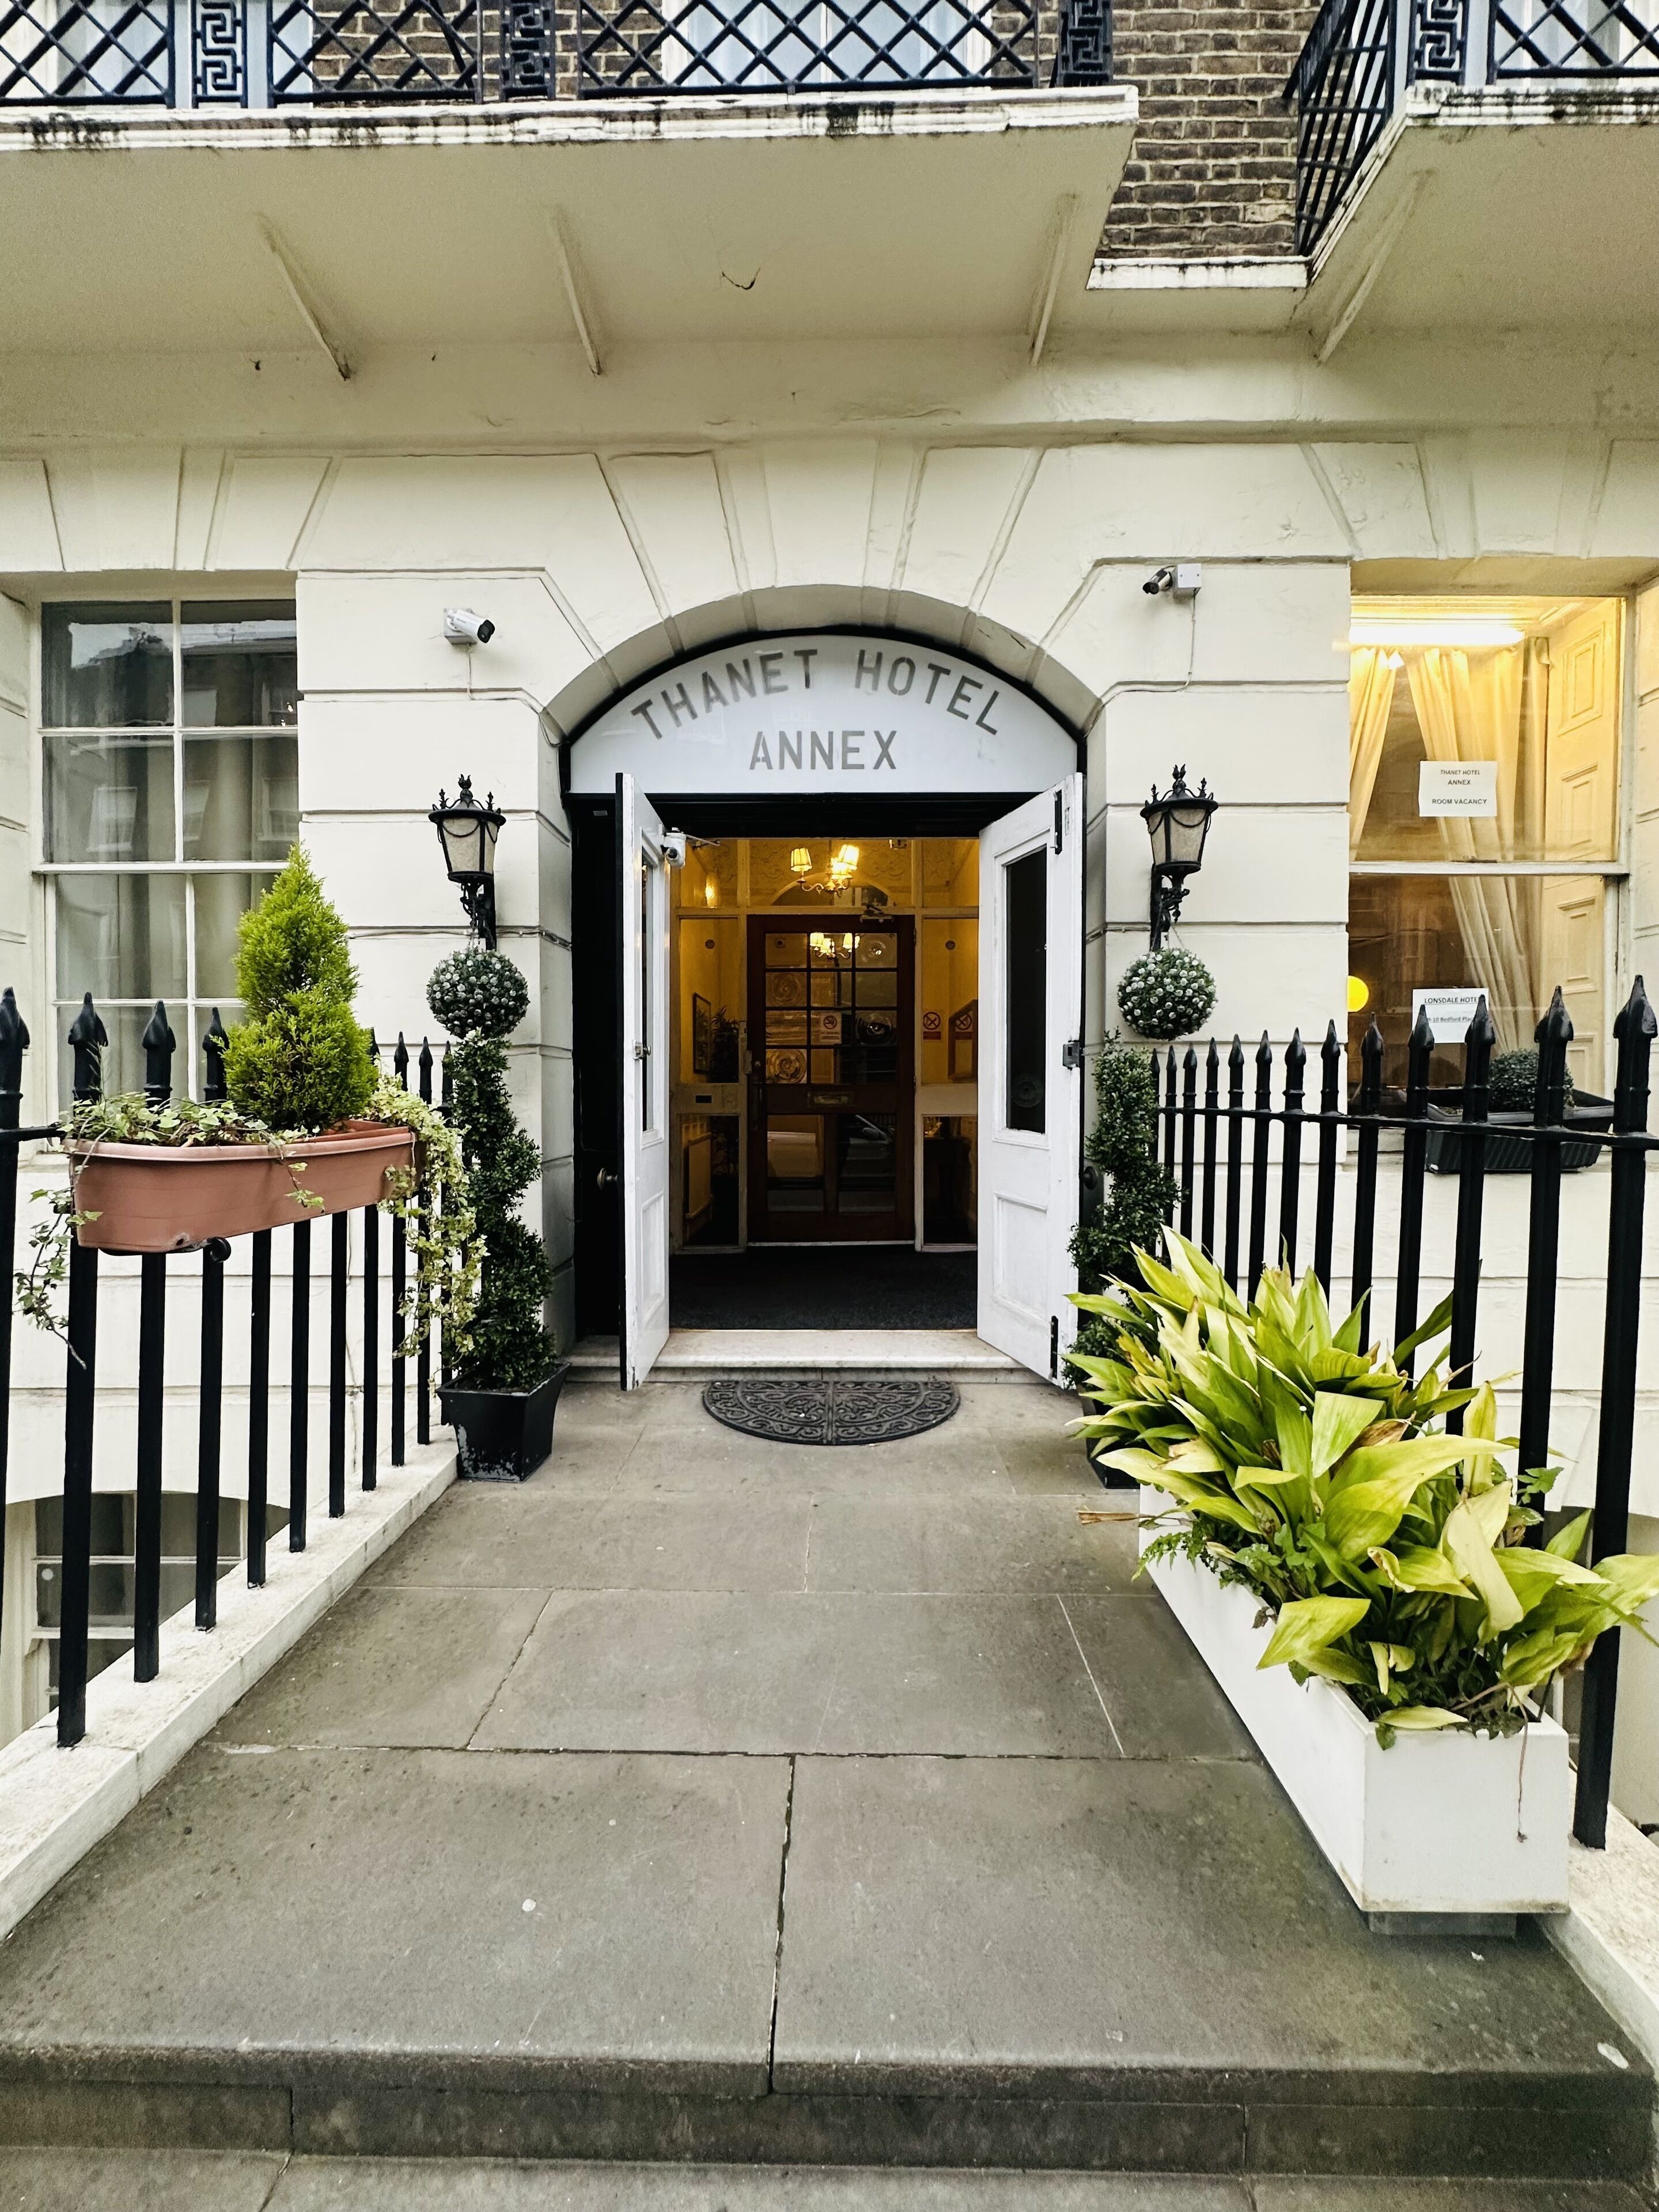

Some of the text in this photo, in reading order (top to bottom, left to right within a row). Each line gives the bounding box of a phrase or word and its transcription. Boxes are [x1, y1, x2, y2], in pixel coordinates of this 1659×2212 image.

[631, 649, 1000, 740] THANET HOTEL
[749, 730, 897, 771] ANNEX
